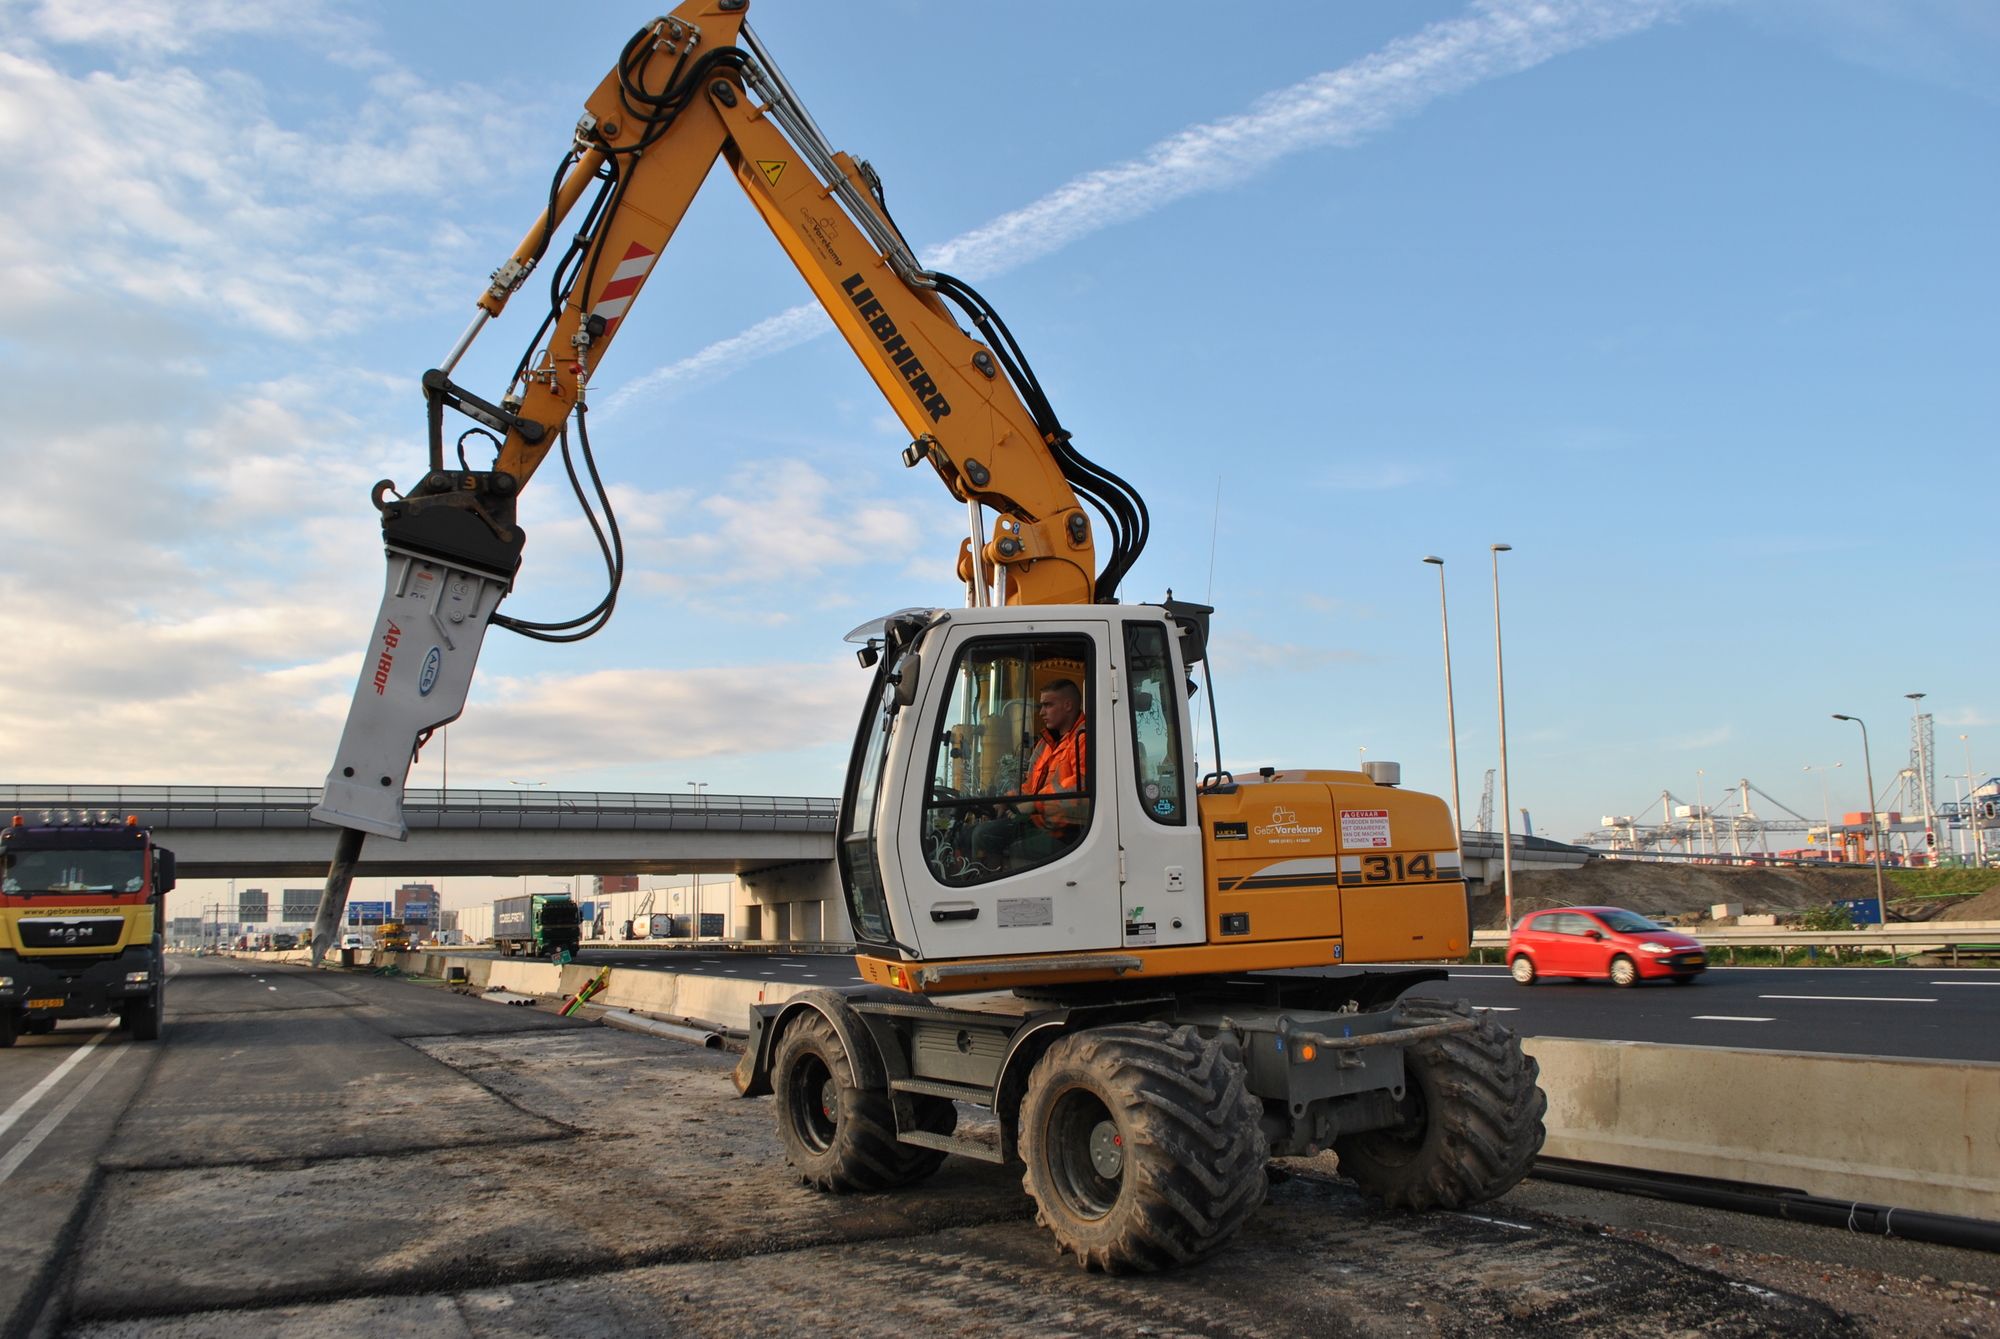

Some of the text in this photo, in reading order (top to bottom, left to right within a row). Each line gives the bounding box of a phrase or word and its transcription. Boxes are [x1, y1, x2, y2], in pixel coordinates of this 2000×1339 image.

[813, 224, 843, 267] Varekamp
[840, 272, 952, 425] LIEBHERR
[373, 618, 401, 696] AB-180F
[422, 654, 438, 688] AJCE
[1254, 825, 1323, 835] Gebr. Varekamp
[1363, 853, 1435, 882] 314
[23, 907, 121, 917] www.gebrvarekamp.nl
[49, 928, 93, 936] MAN
